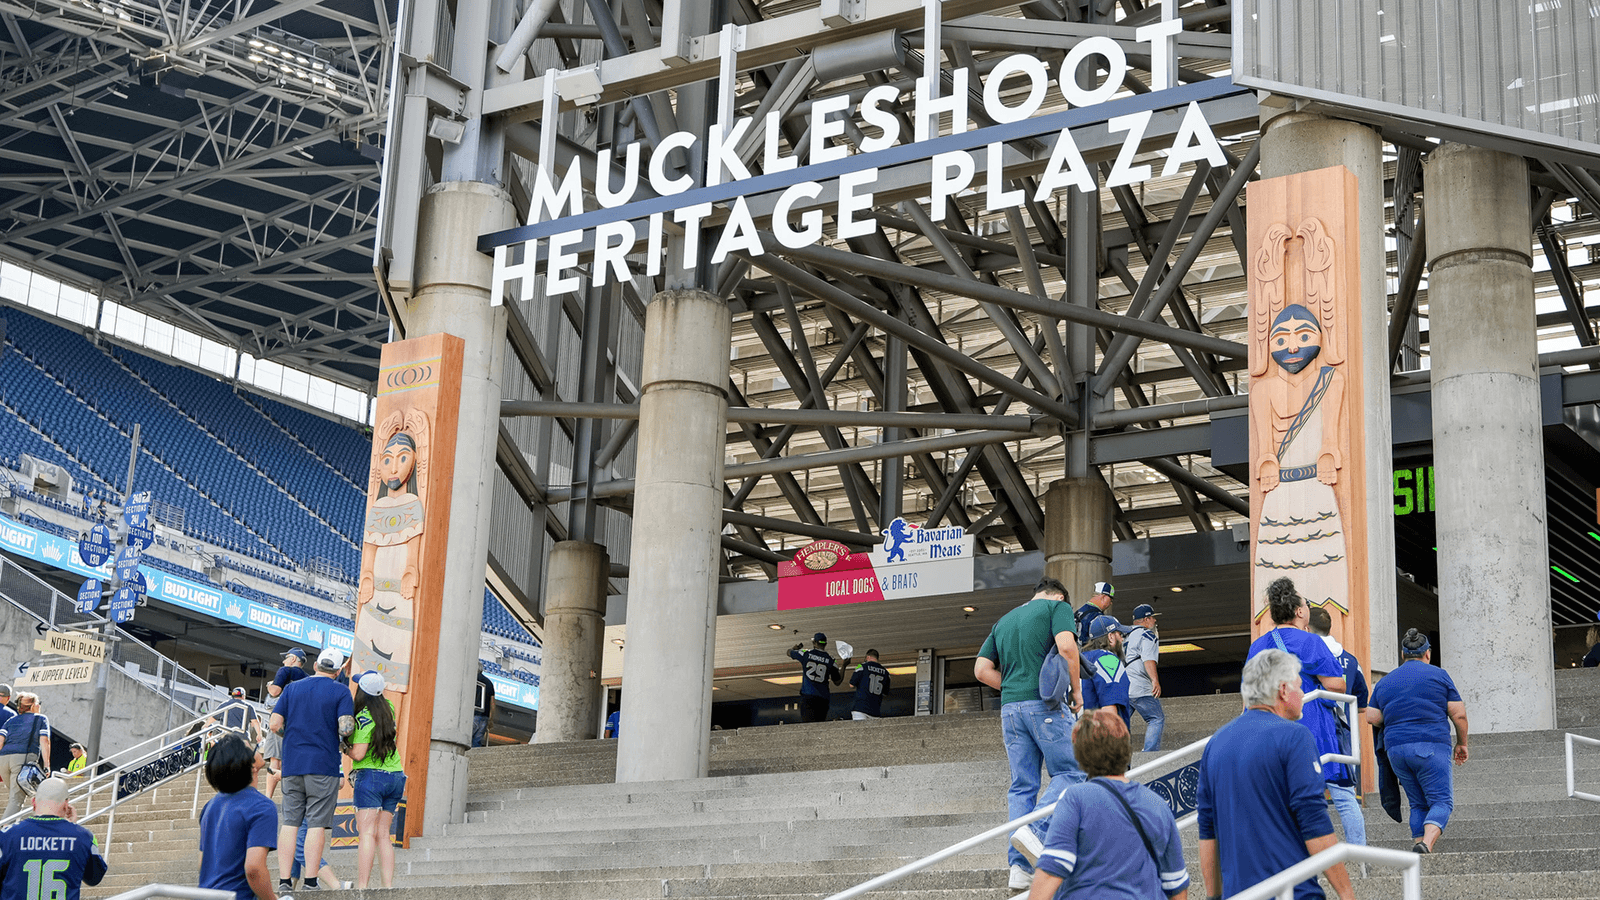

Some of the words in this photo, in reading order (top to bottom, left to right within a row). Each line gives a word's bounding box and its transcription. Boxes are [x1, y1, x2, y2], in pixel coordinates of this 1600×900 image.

[526, 18, 1183, 226] MUCKLESHOOT
[490, 167, 878, 307] HERITAGE
[930, 100, 1228, 222] PLAZA
[125, 504, 147, 514] SECTIONS
[2, 525, 34, 548] LIGHT
[92, 532, 103, 545] 100
[916, 525, 962, 543] Bavarian
[84, 542, 108, 555] SECTIONS
[796, 541, 847, 561] HEMPLER'S
[930, 544, 962, 558] Meats
[90, 554, 100, 565] 130
[118, 558, 138, 568] SECTIONS
[825, 579, 850, 597] LOCAL
[852, 576, 875, 594] DOGS
[881, 576, 889, 591] &
[892, 572, 918, 590] BRATS
[80, 590, 100, 600] SECTIONS
[165, 580, 187, 599] BUD
[188, 588, 220, 609] LIGHT
[112, 600, 133, 610] SECTIONS
[250, 608, 271, 624] BUD
[271, 615, 301, 634] LIGHT
[50, 636, 76, 652] NORTH
[78, 642, 101, 658] PLAZA
[331, 633, 351, 648] BUD
[30, 670, 41, 682] NE
[41, 668, 64, 682] UPPER
[65, 666, 89, 680] LEVELS
[805, 661, 827, 683] 29
[494, 682, 518, 697] LIGHT
[868, 673, 884, 695] 16
[20, 836, 77, 851] LOCKETT
[23, 859, 70, 900] 16
